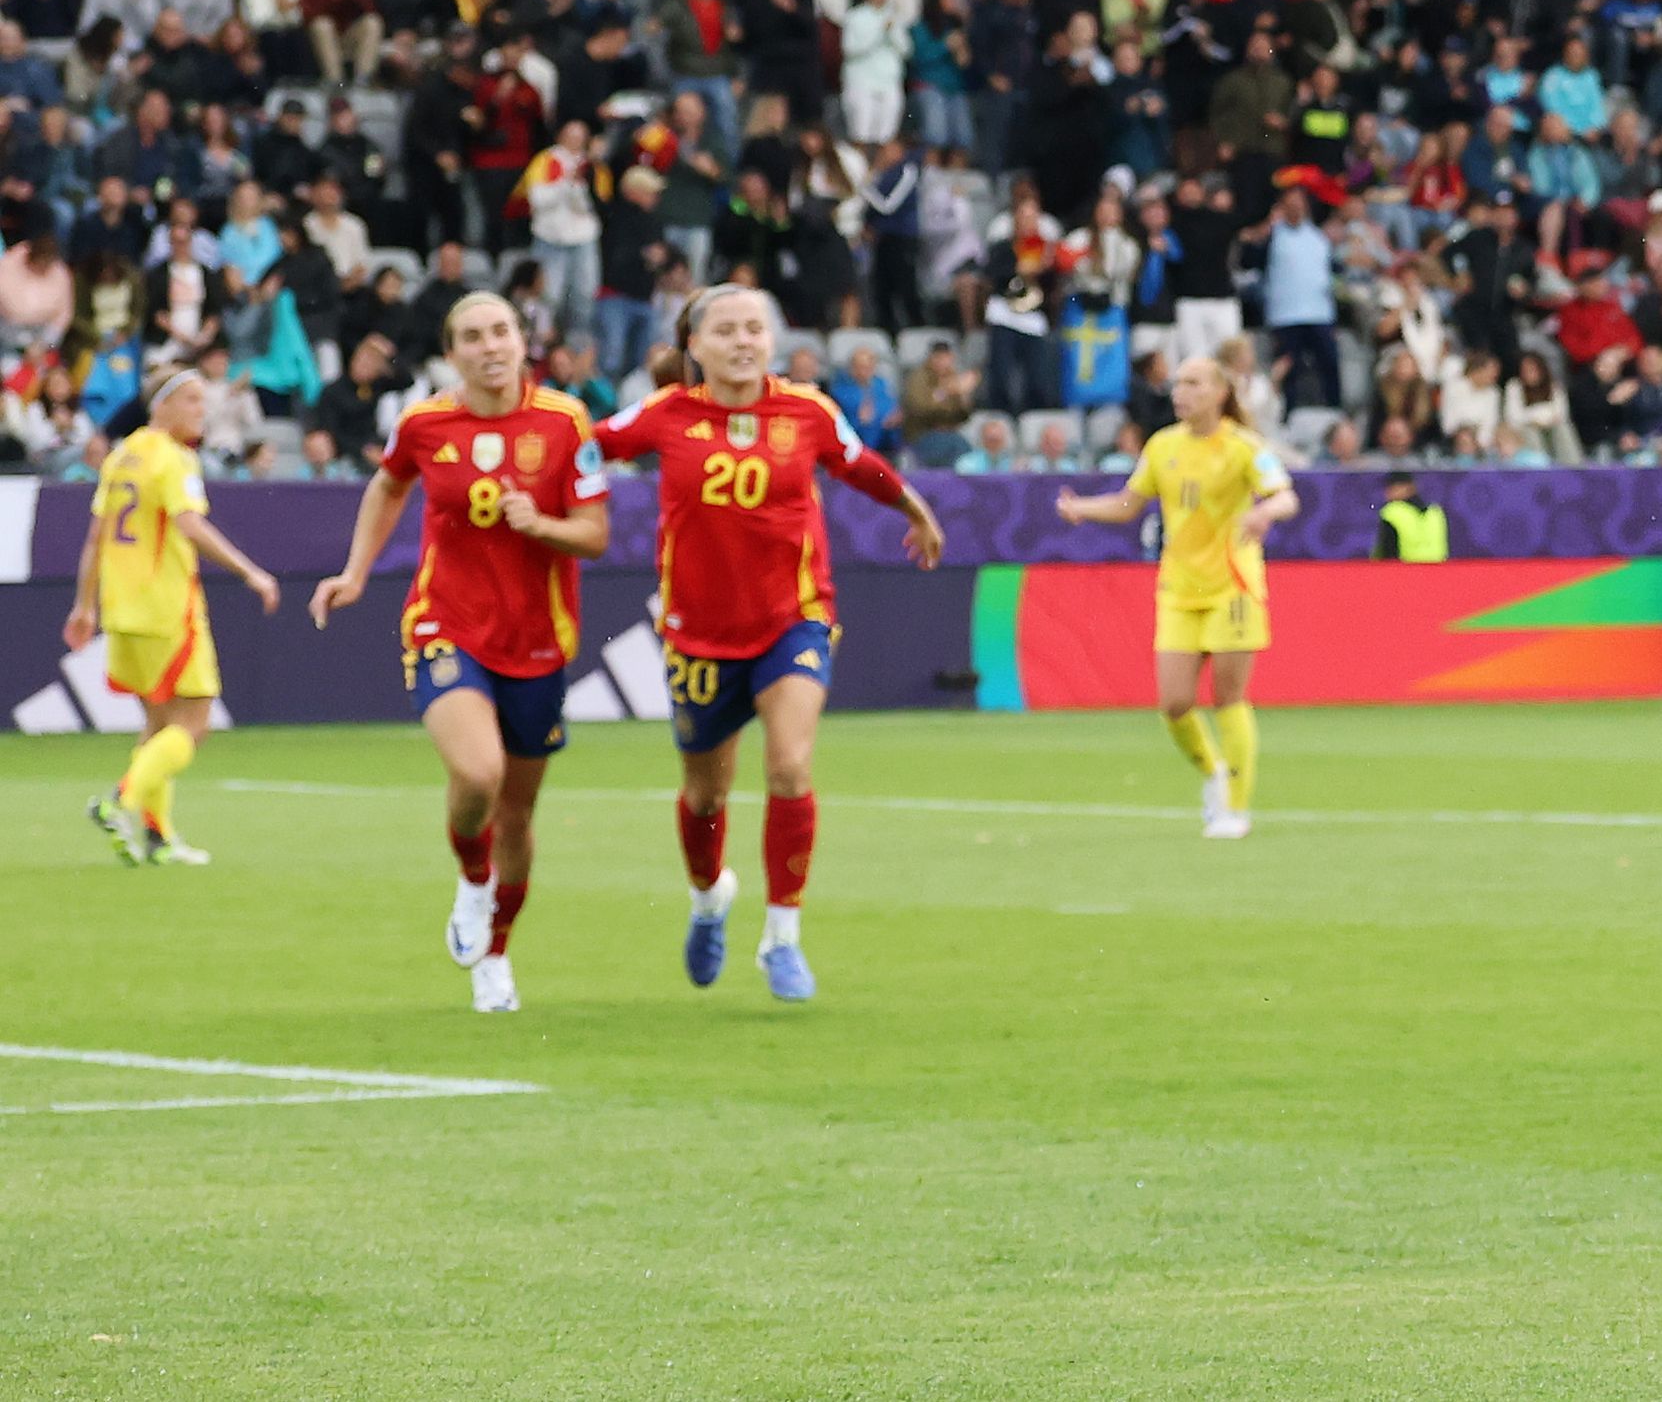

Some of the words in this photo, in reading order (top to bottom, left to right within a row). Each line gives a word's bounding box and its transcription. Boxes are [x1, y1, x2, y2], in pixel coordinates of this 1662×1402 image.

[468, 477, 504, 529] 8
[701, 450, 772, 510] 20
[665, 651, 720, 706] 20
